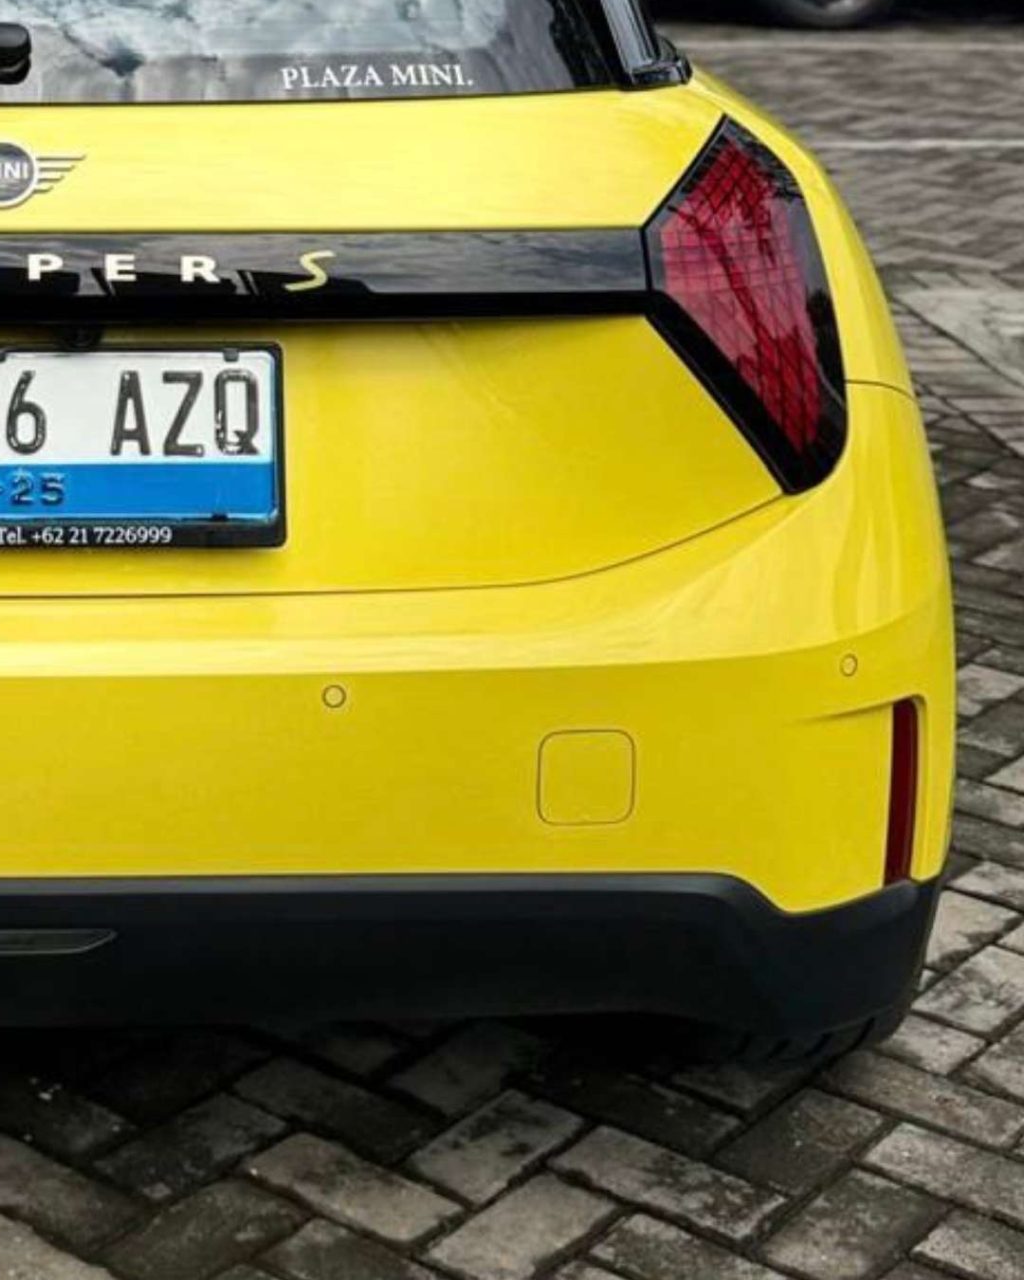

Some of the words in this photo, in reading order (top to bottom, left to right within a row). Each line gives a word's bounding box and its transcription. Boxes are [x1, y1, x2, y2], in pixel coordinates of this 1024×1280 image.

[281, 66, 383, 89] PLAZA
[285, 250, 336, 292] S
[110, 370, 260, 456] AZQ
[32, 527, 63, 544] +62
[69, 527, 88, 543] 21
[93, 527, 172, 543] 7226999
